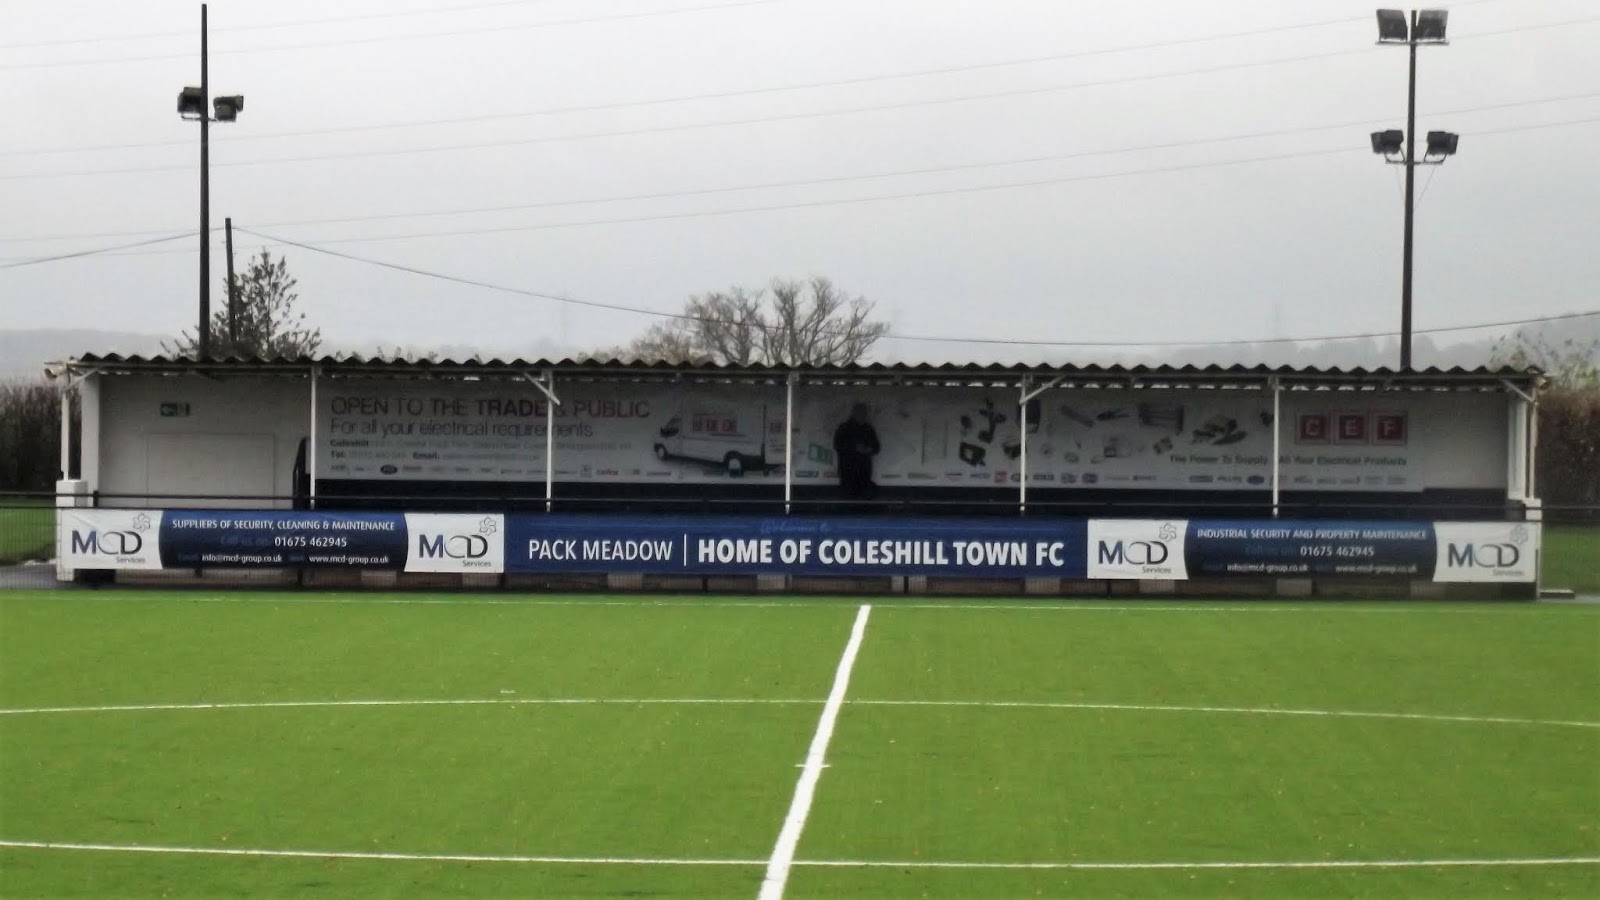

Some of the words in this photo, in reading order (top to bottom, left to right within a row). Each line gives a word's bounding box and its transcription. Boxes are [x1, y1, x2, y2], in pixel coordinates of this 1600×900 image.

[331, 397, 388, 416] OPEN
[393, 397, 424, 416] TO
[429, 398, 469, 417] THE
[476, 398, 547, 418] TRADE
[572, 399, 651, 418] PUBLIC
[331, 417, 357, 434] For
[361, 419, 377, 434] all
[381, 422, 415, 438] your
[420, 420, 488, 436] electrical
[172, 519, 217, 529] SUPPLIERS
[220, 520, 231, 529] OF
[234, 520, 275, 531] SECURITY,
[277, 520, 320, 530] CLEANING
[322, 521, 330, 530] &
[332, 521, 396, 531] MAINTENANCE
[71, 530, 143, 555] MCD
[274, 537, 306, 547] 01675
[309, 537, 347, 548] 462945
[1197, 529, 1247, 539] INDUSTRIAL
[1250, 529, 1291, 539] SECURITY
[1293, 530, 1313, 539] AND
[1315, 530, 1359, 540] PROPERTY
[1362, 530, 1427, 541] MAINTENANCE
[419, 534, 489, 559] MCD
[529, 540, 577, 560] PACK
[583, 540, 673, 561] MEADOW
[698, 539, 773, 564] HOME
[779, 539, 812, 564] OF
[818, 540, 949, 565] COLESHILL
[952, 541, 1027, 566] TOWN
[1035, 542, 1065, 567] FC
[1098, 540, 1169, 566] MCD
[1300, 546, 1333, 557] 01675
[1336, 546, 1375, 557] 462945
[117, 556, 146, 564] Services
[202, 553, 283, 564] info@mcd-group.co.uk
[309, 554, 390, 565] www.mcd-group.co.uk
[1448, 543, 1519, 568] MCD
[462, 560, 492, 568] Services
